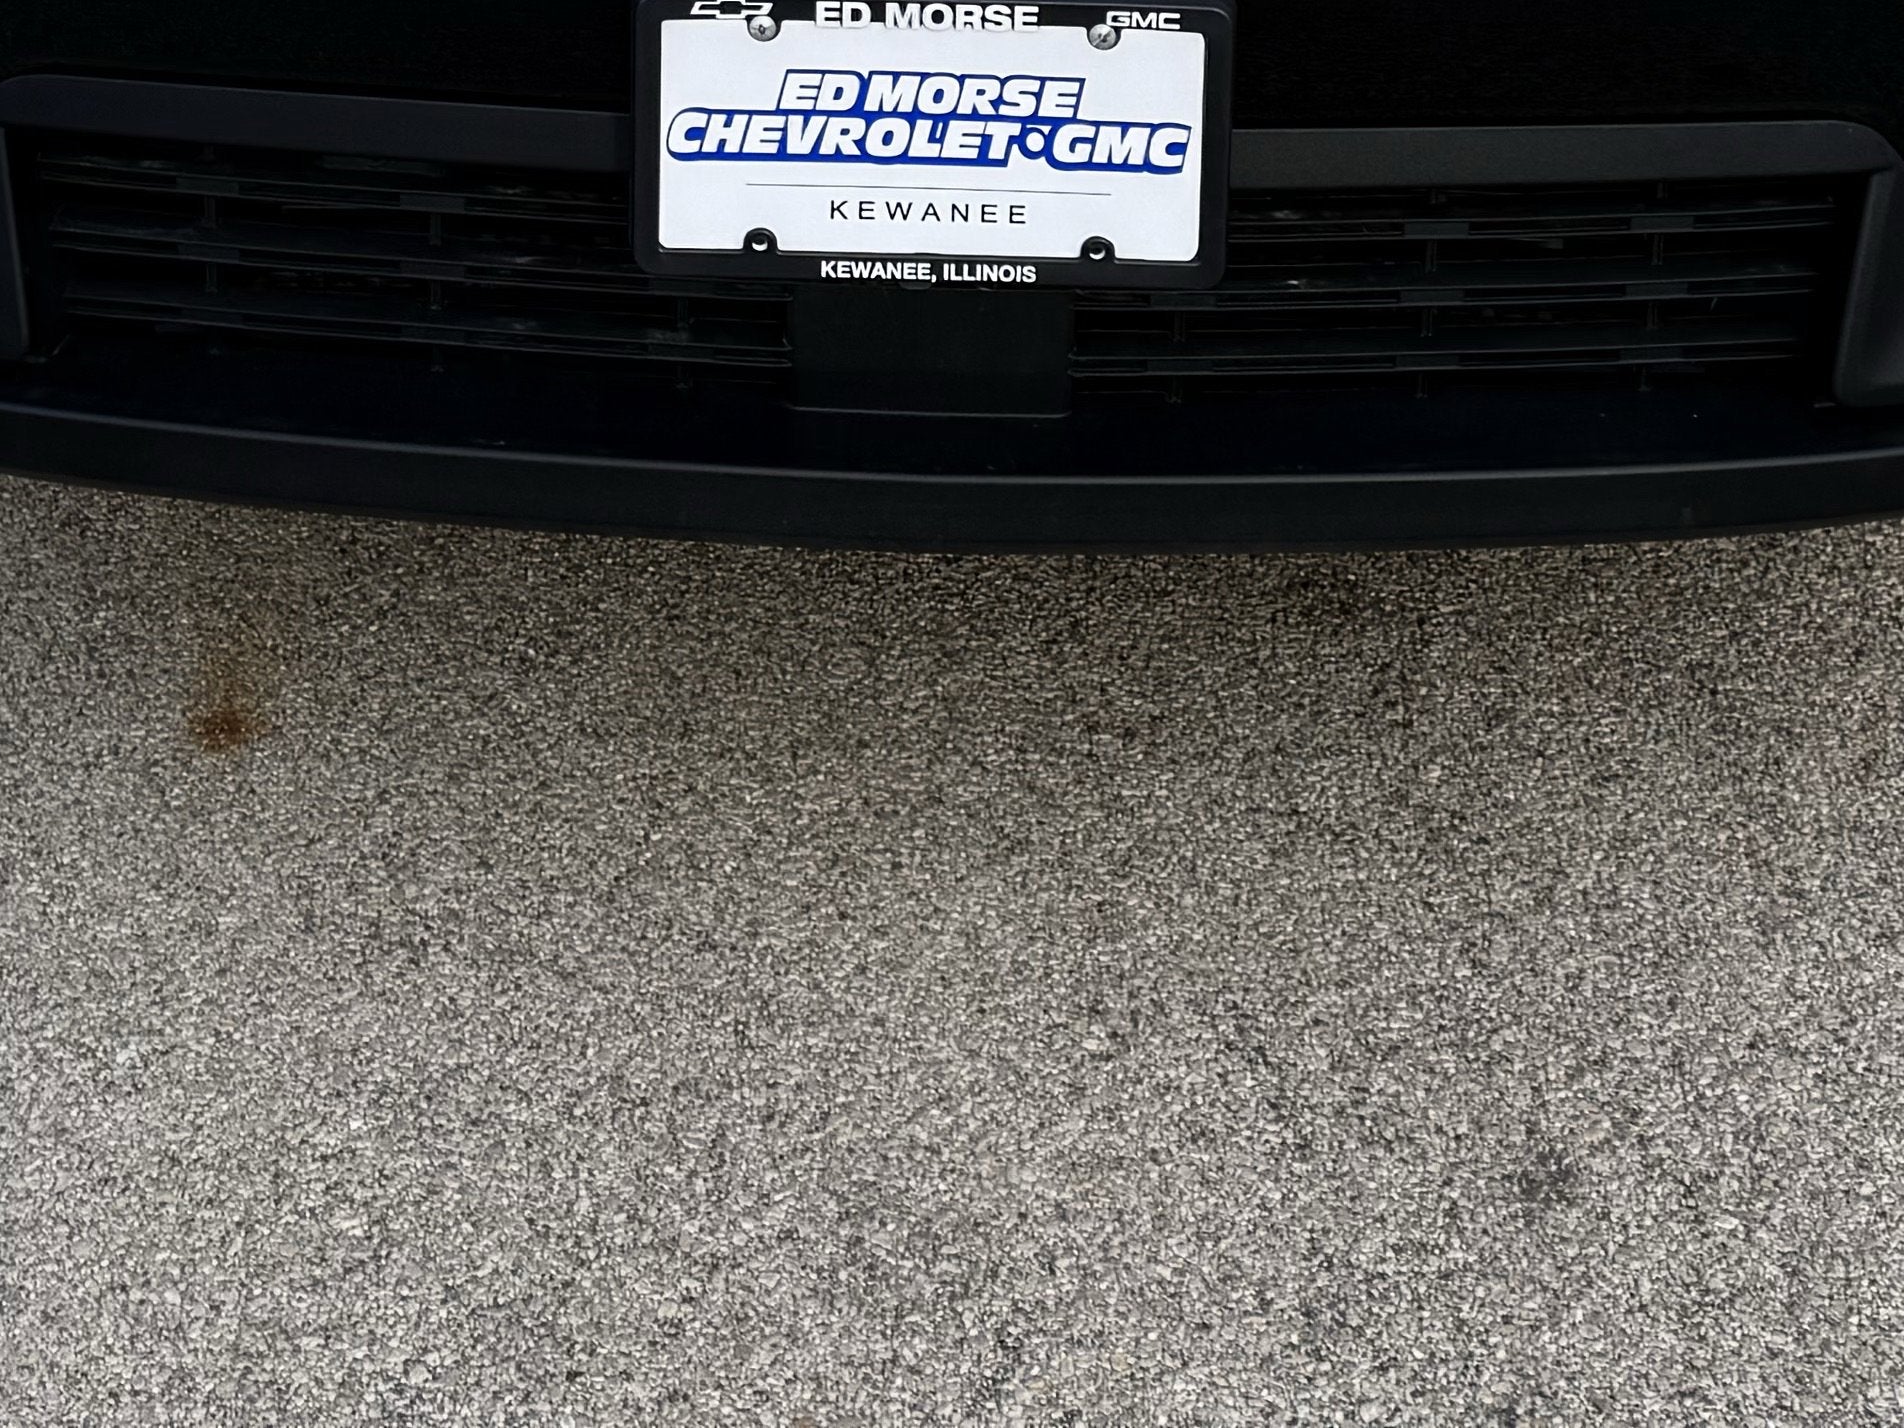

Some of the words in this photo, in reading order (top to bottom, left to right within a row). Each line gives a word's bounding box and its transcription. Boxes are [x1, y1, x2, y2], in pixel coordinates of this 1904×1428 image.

[815, 1, 872, 29] ED
[885, 2, 1040, 32] MORSE
[1106, 11, 1181, 29] GMC
[778, 70, 862, 112] ED
[863, 73, 1082, 118] MORSE
[829, 199, 1027, 225] KEWANEE
[820, 259, 938, 284] KEWANEE,
[943, 262, 1038, 284] ILLINOIS
